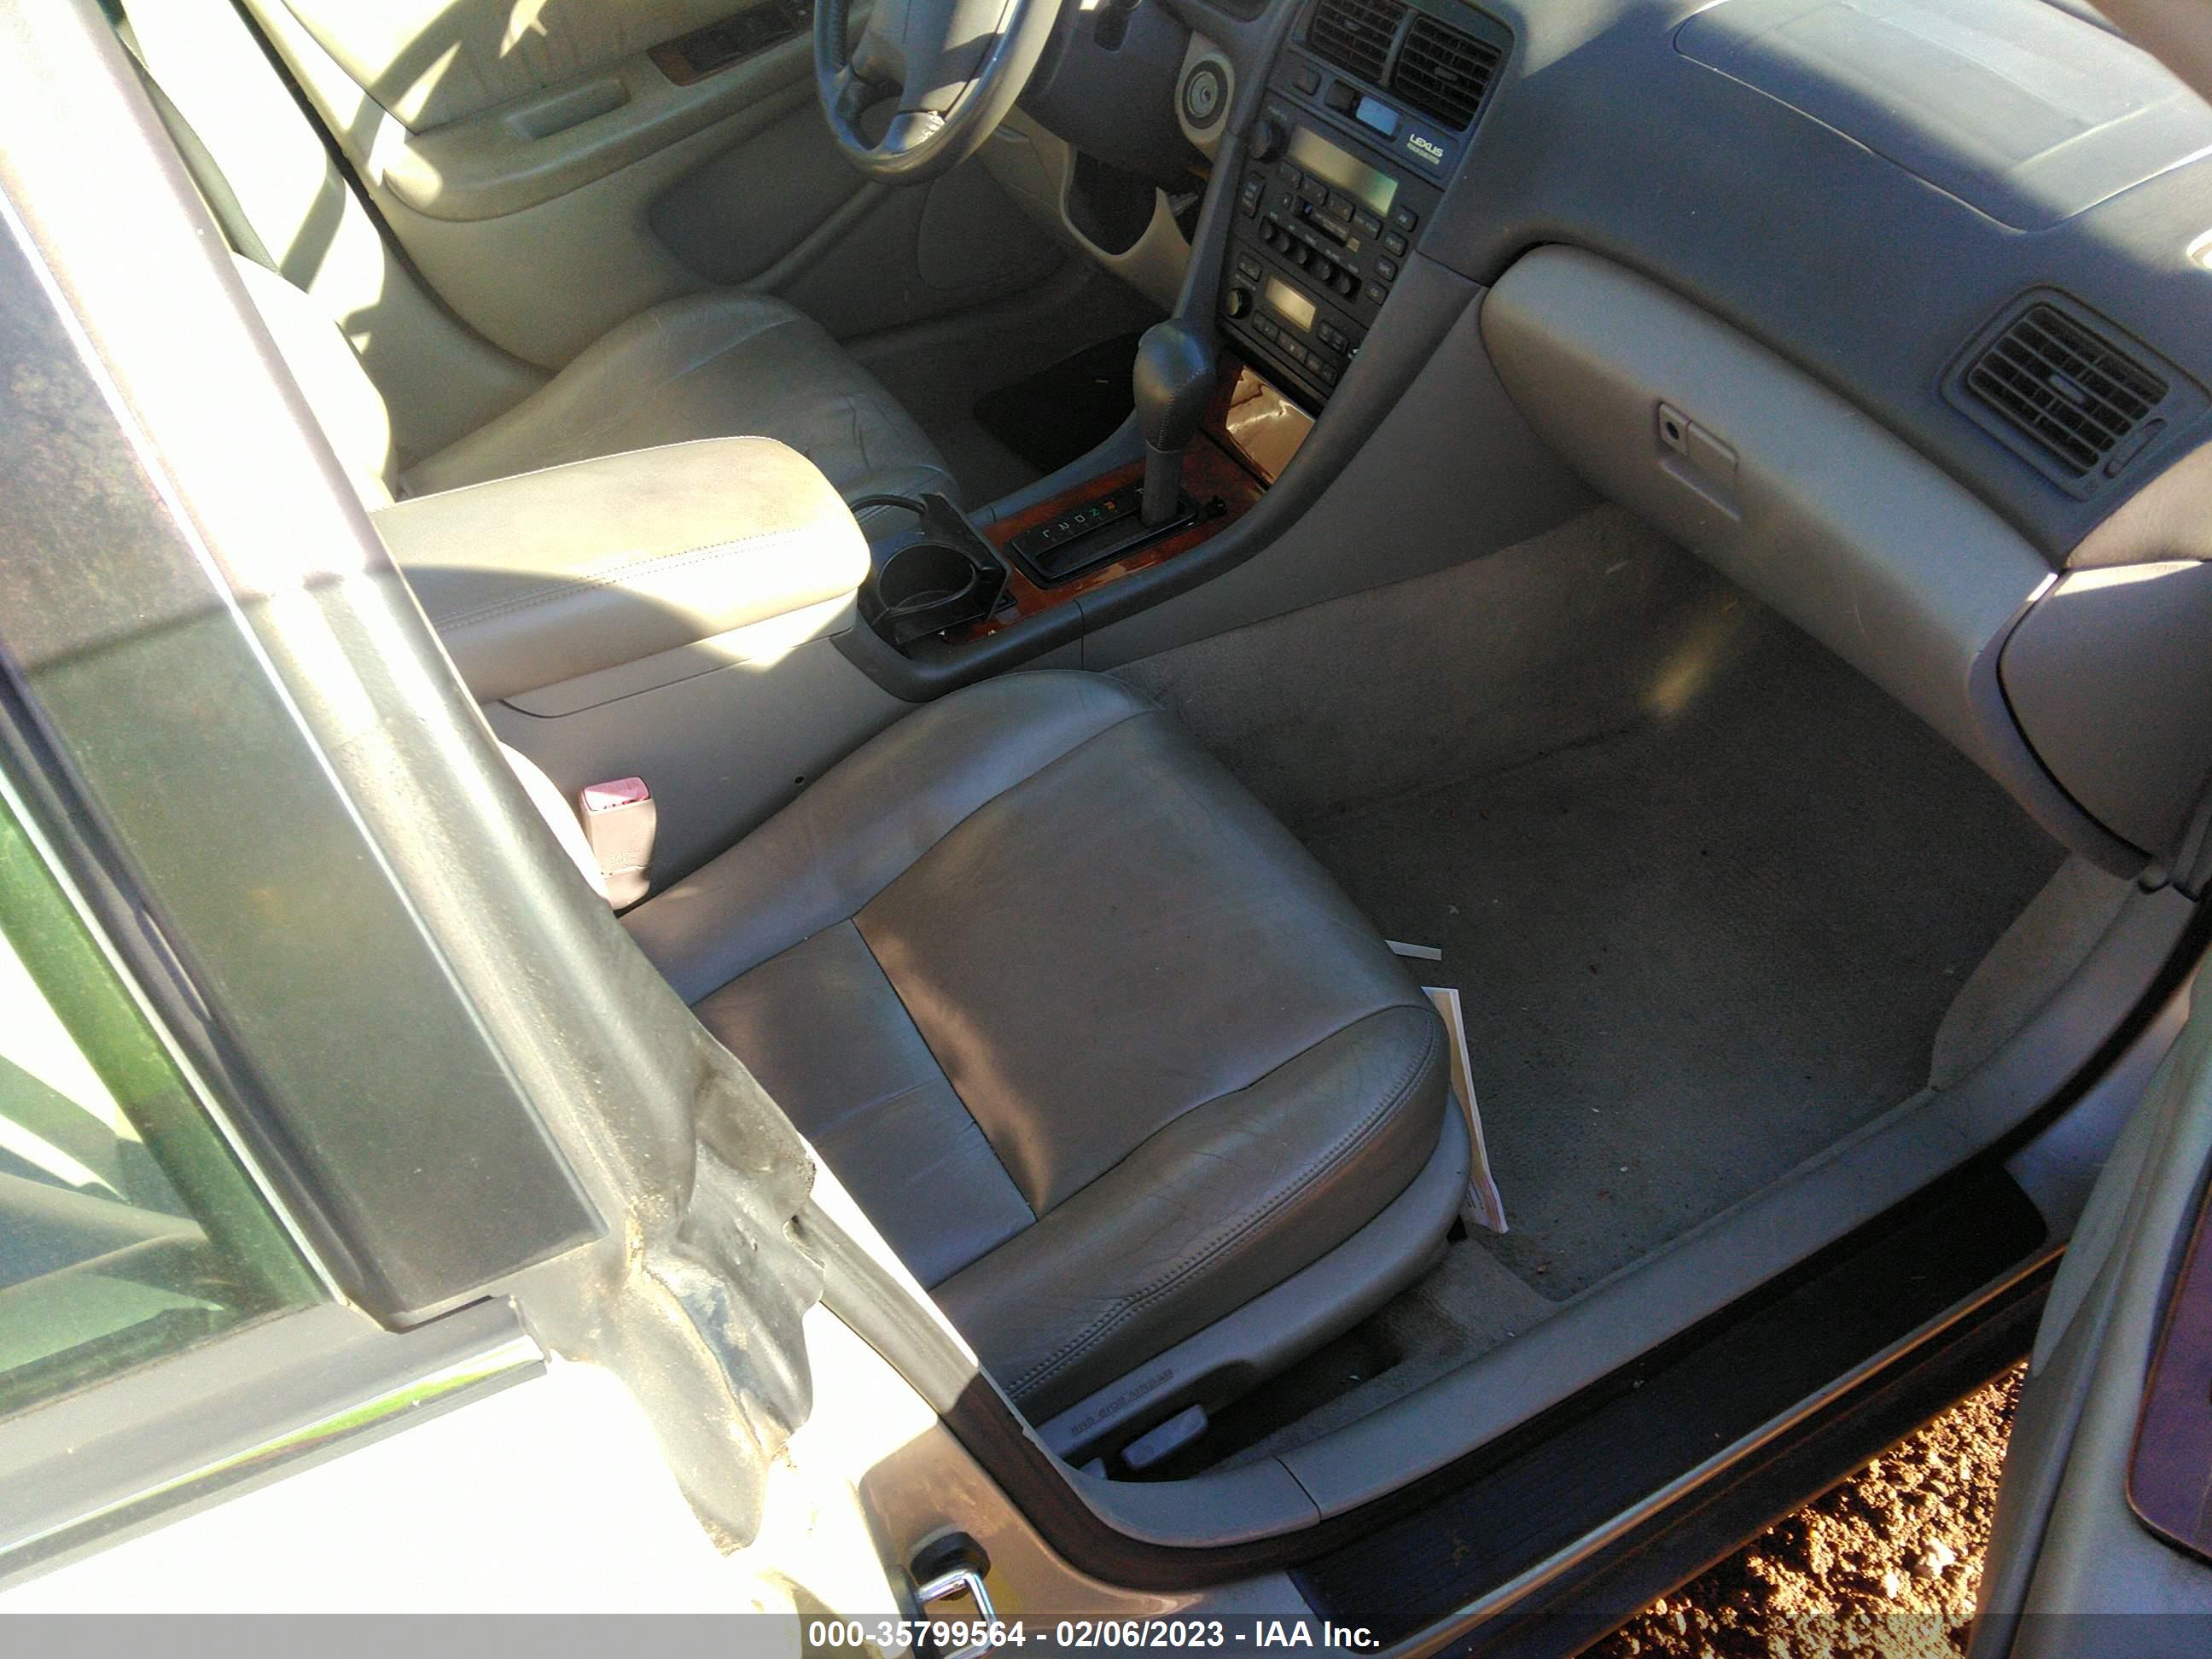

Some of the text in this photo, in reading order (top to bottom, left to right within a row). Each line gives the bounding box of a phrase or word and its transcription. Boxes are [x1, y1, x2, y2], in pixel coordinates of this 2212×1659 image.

[1409, 133, 1444, 158] LEXUS
[1074, 514, 1086, 523] D
[1058, 521, 1070, 531] 2
[1042, 529, 1051, 538] L
